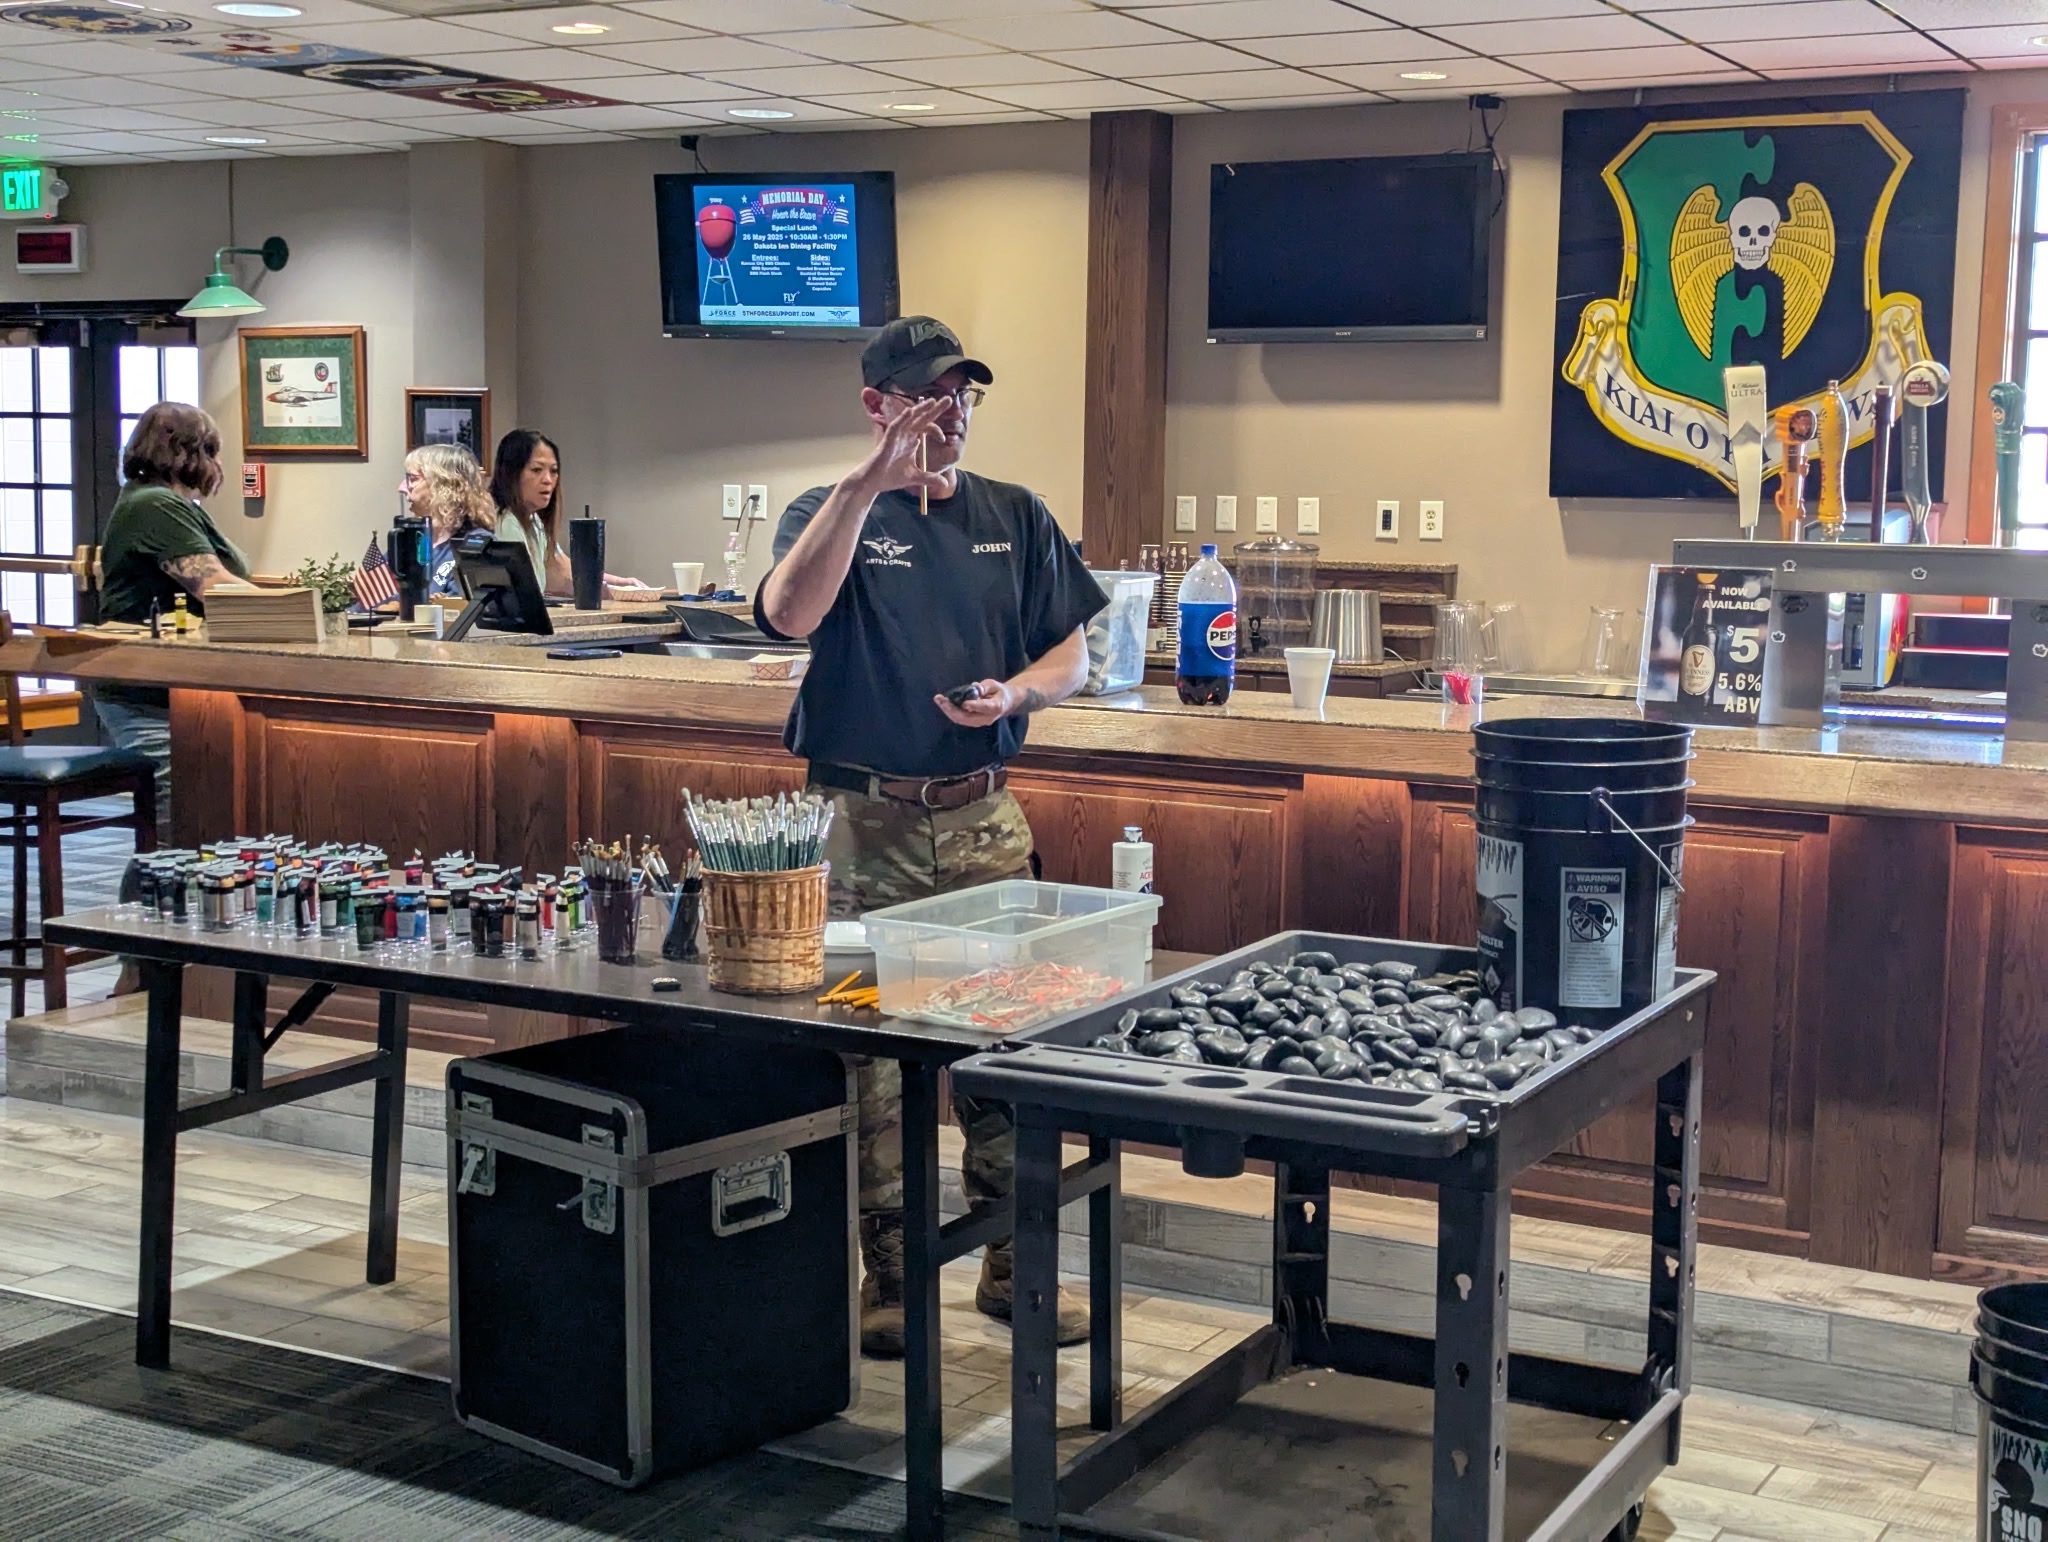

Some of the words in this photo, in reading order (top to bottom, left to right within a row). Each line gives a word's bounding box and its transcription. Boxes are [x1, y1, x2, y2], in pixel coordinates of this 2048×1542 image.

[3, 169, 41, 211] EXIT
[762, 191, 806, 205] MEMORIAL
[808, 192, 825, 205] DAY
[771, 224, 796, 232] Special
[752, 234, 766, 242] May
[767, 233, 784, 241] 2025
[789, 233, 818, 241] 10:30AM
[754, 242, 778, 250] Dakota
[790, 243, 812, 251] Dining
[812, 242, 837, 251] Facility
[751, 254, 779, 262] Entrees:
[810, 254, 831, 262] Sides:
[783, 293, 797, 302] FLY
[1731, 388, 1764, 398] ULTRA
[1603, 368, 1675, 437] KIAI
[1686, 422, 1709, 450] O
[972, 542, 1012, 554] JOHN
[1721, 586, 1749, 596] NOW
[1702, 600, 1764, 611] AVAILABLE
[1210, 630, 1237, 641] PEPS
[1718, 672, 1762, 692] 5.6%
[1723, 695, 1761, 714] ABV
[1575, 874, 1621, 883] WARNING
[1576, 884, 1608, 893] AVISO
[2001, 1504, 2043, 1542] SNO
